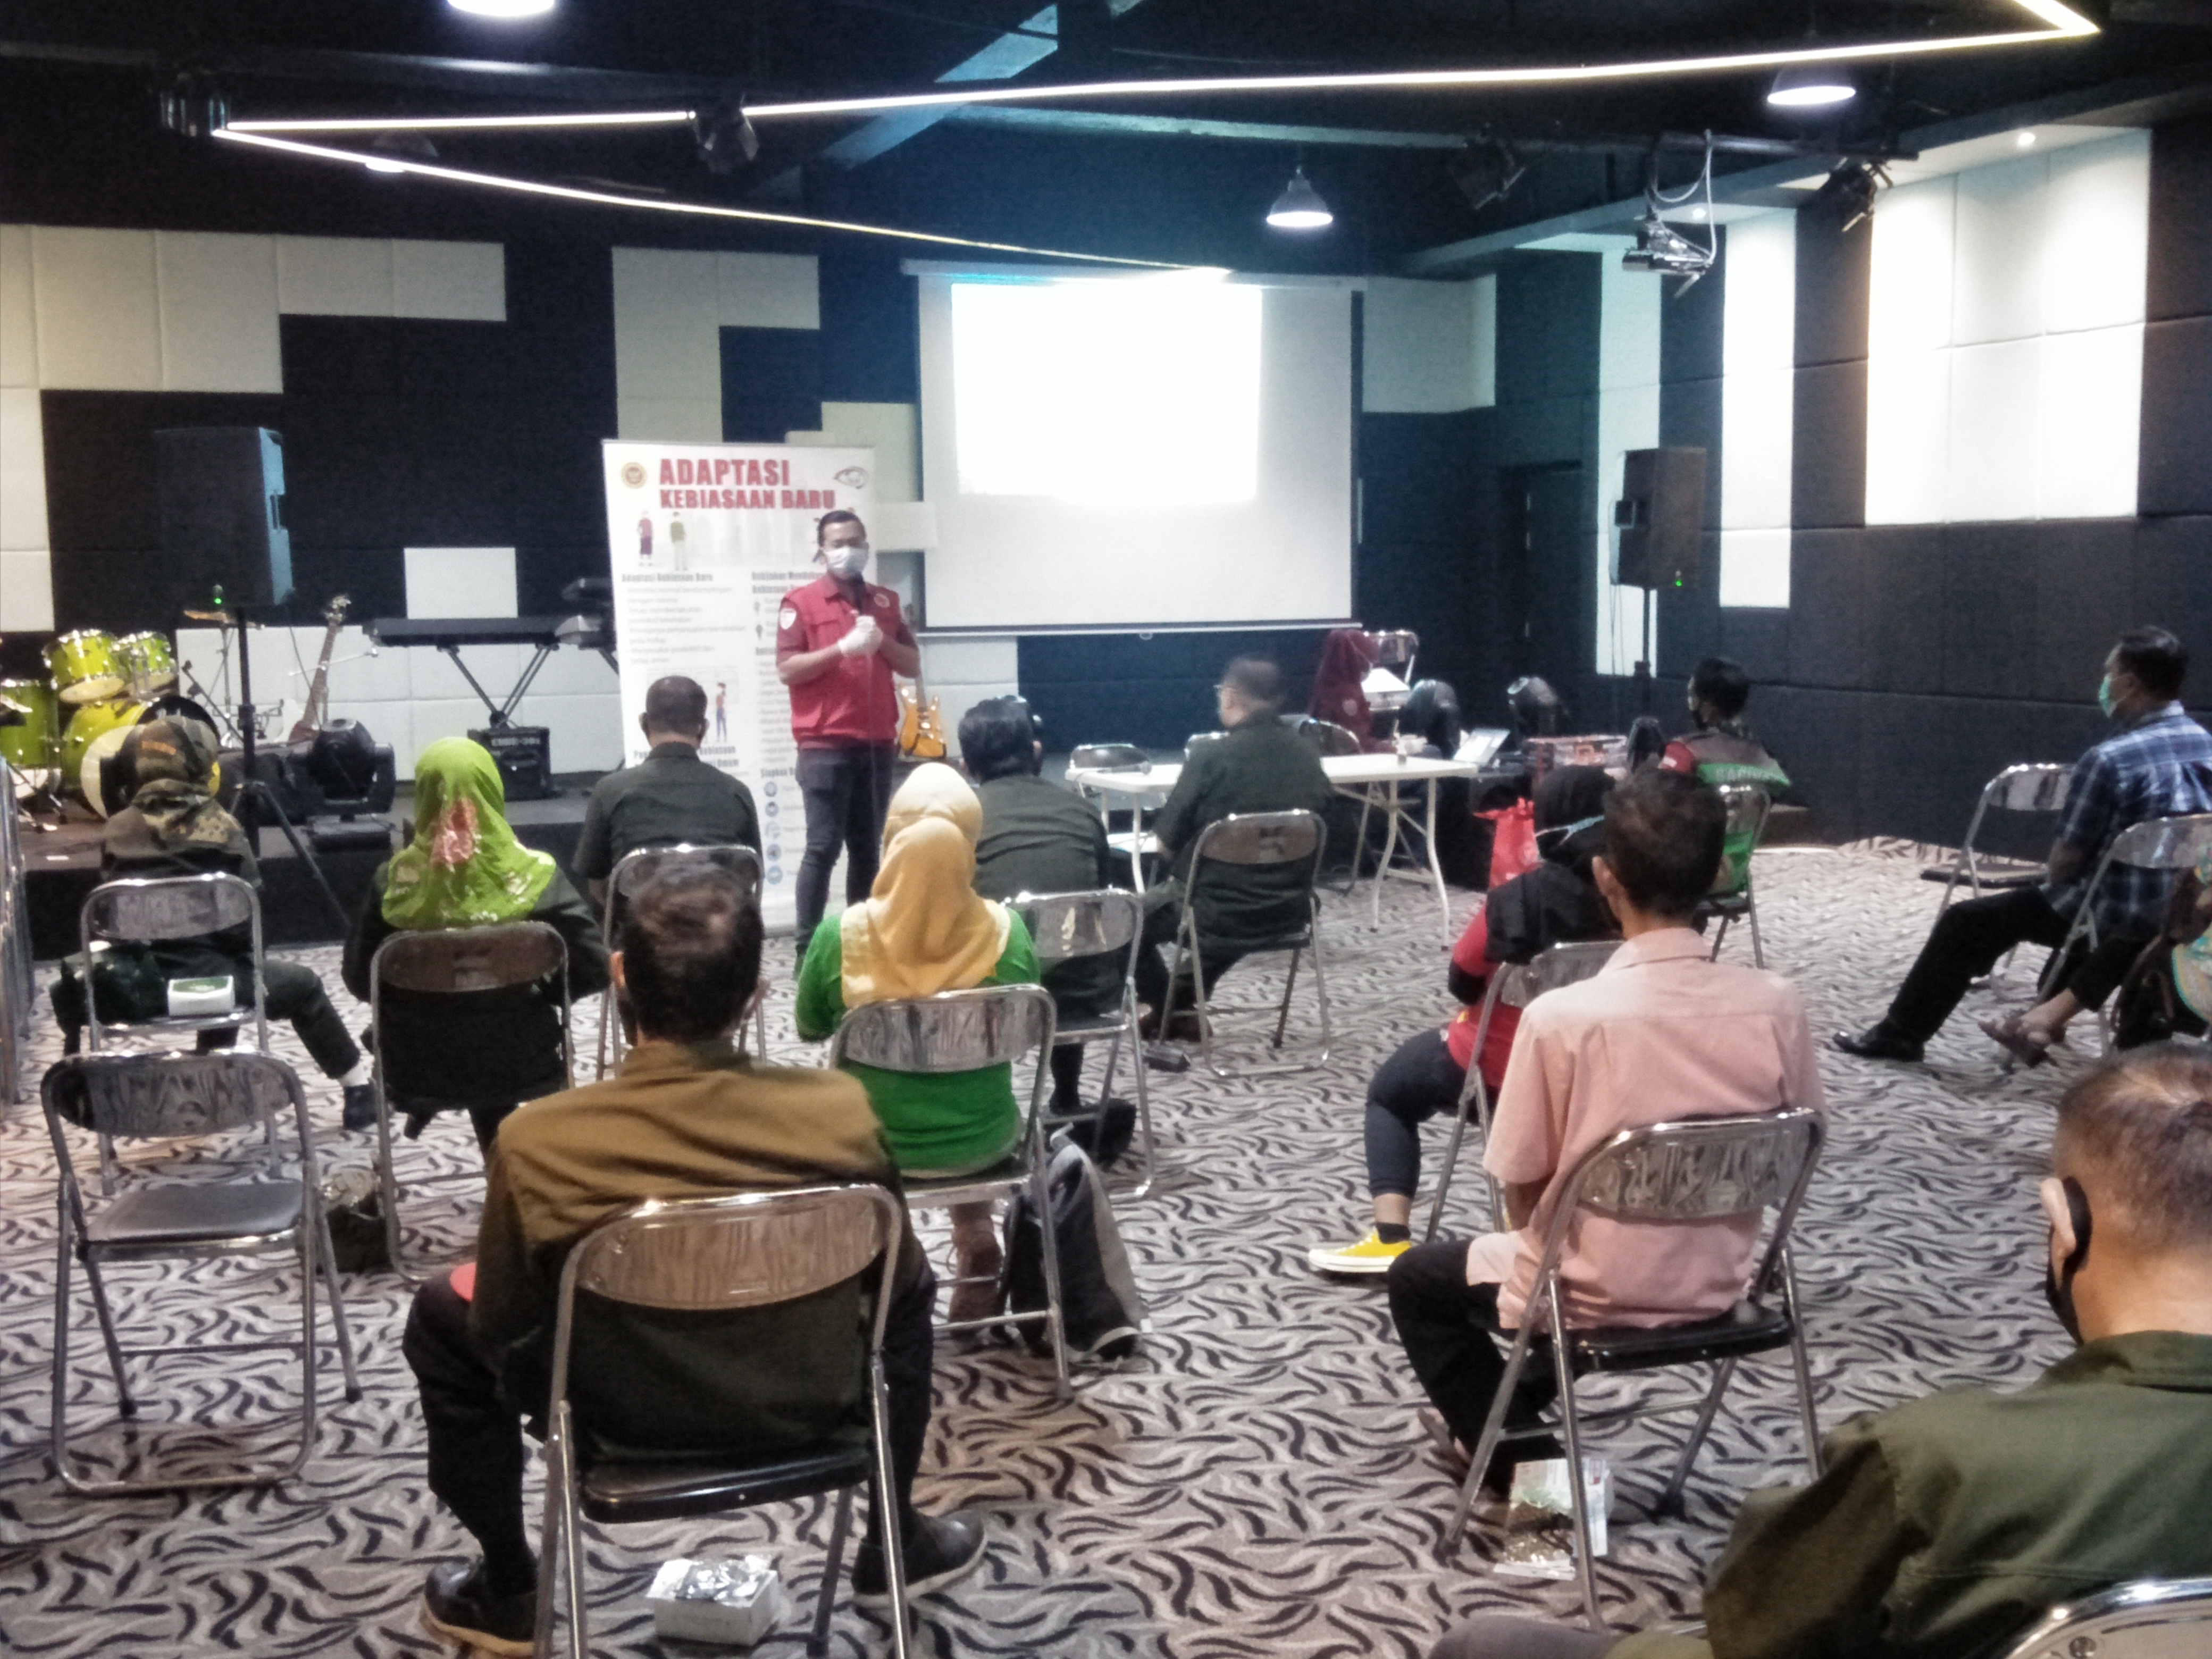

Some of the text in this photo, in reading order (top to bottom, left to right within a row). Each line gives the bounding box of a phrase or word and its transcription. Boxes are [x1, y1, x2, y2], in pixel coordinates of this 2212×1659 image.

[660, 459, 790, 485] ADAPTASI
[660, 490, 835, 509] KEBIASAAN BARU
